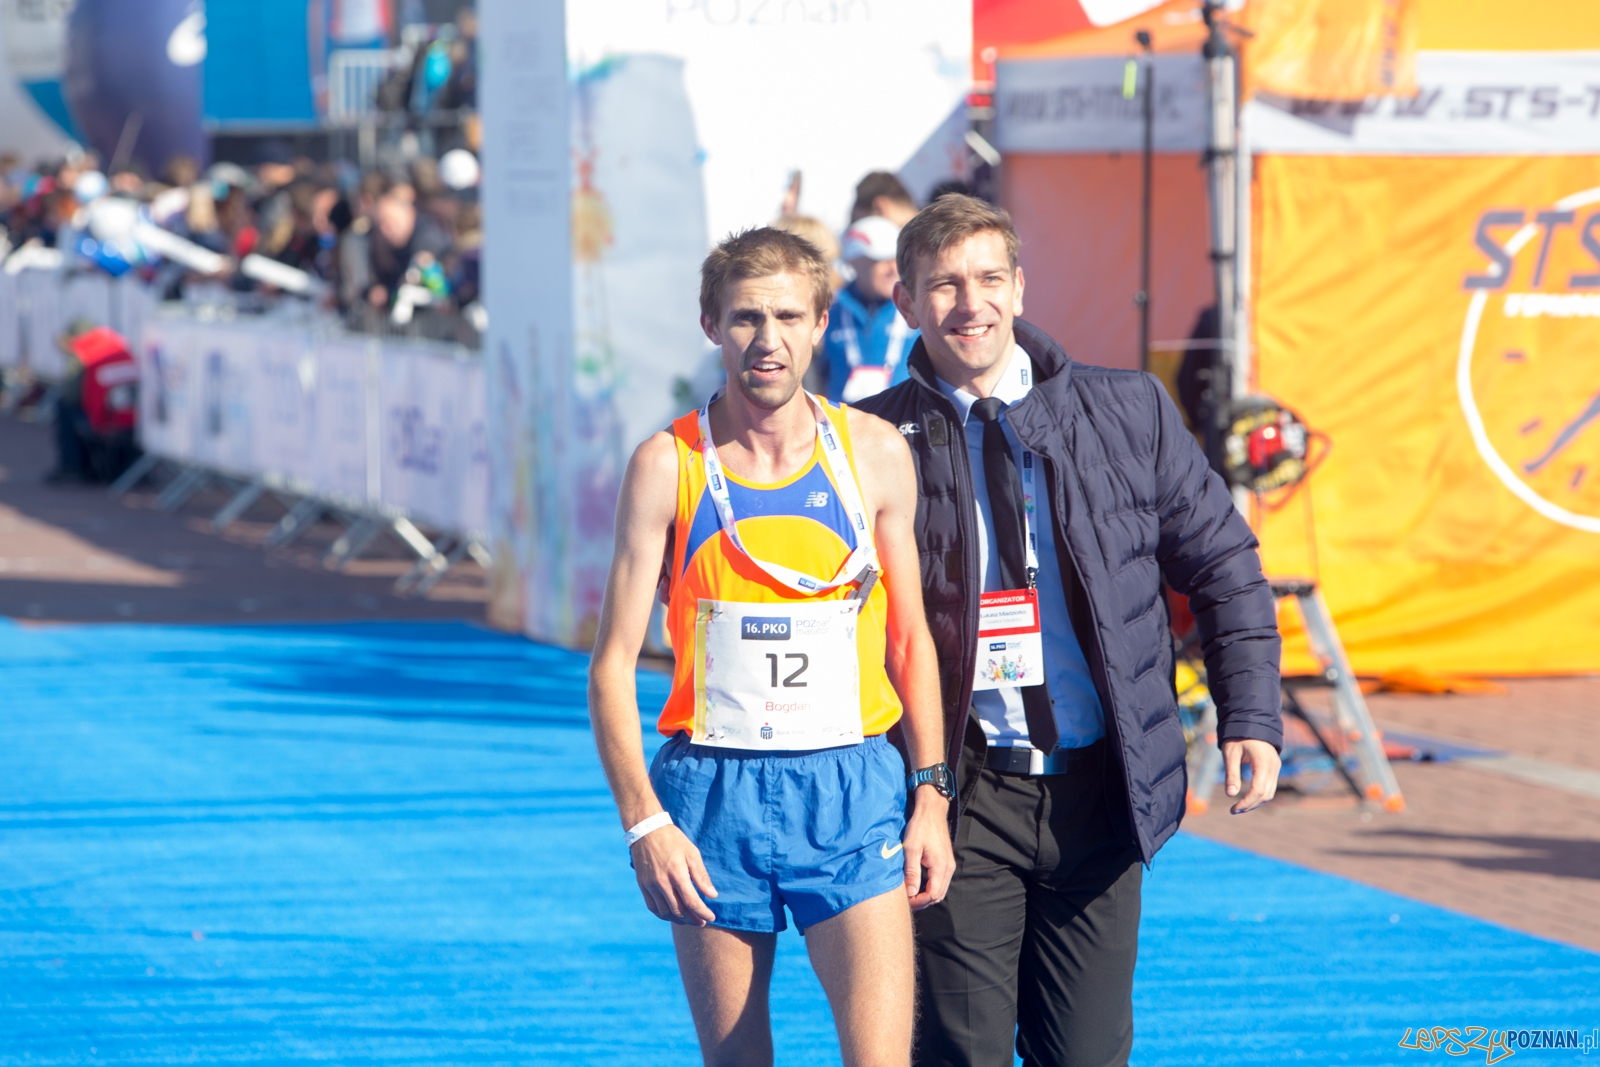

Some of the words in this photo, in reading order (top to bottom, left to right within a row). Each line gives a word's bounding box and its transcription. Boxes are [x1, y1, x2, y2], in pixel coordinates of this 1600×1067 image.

[980, 596, 1025, 605] ORGANIZATOR
[765, 653, 809, 688] 12
[765, 701, 811, 713] Bogdan
